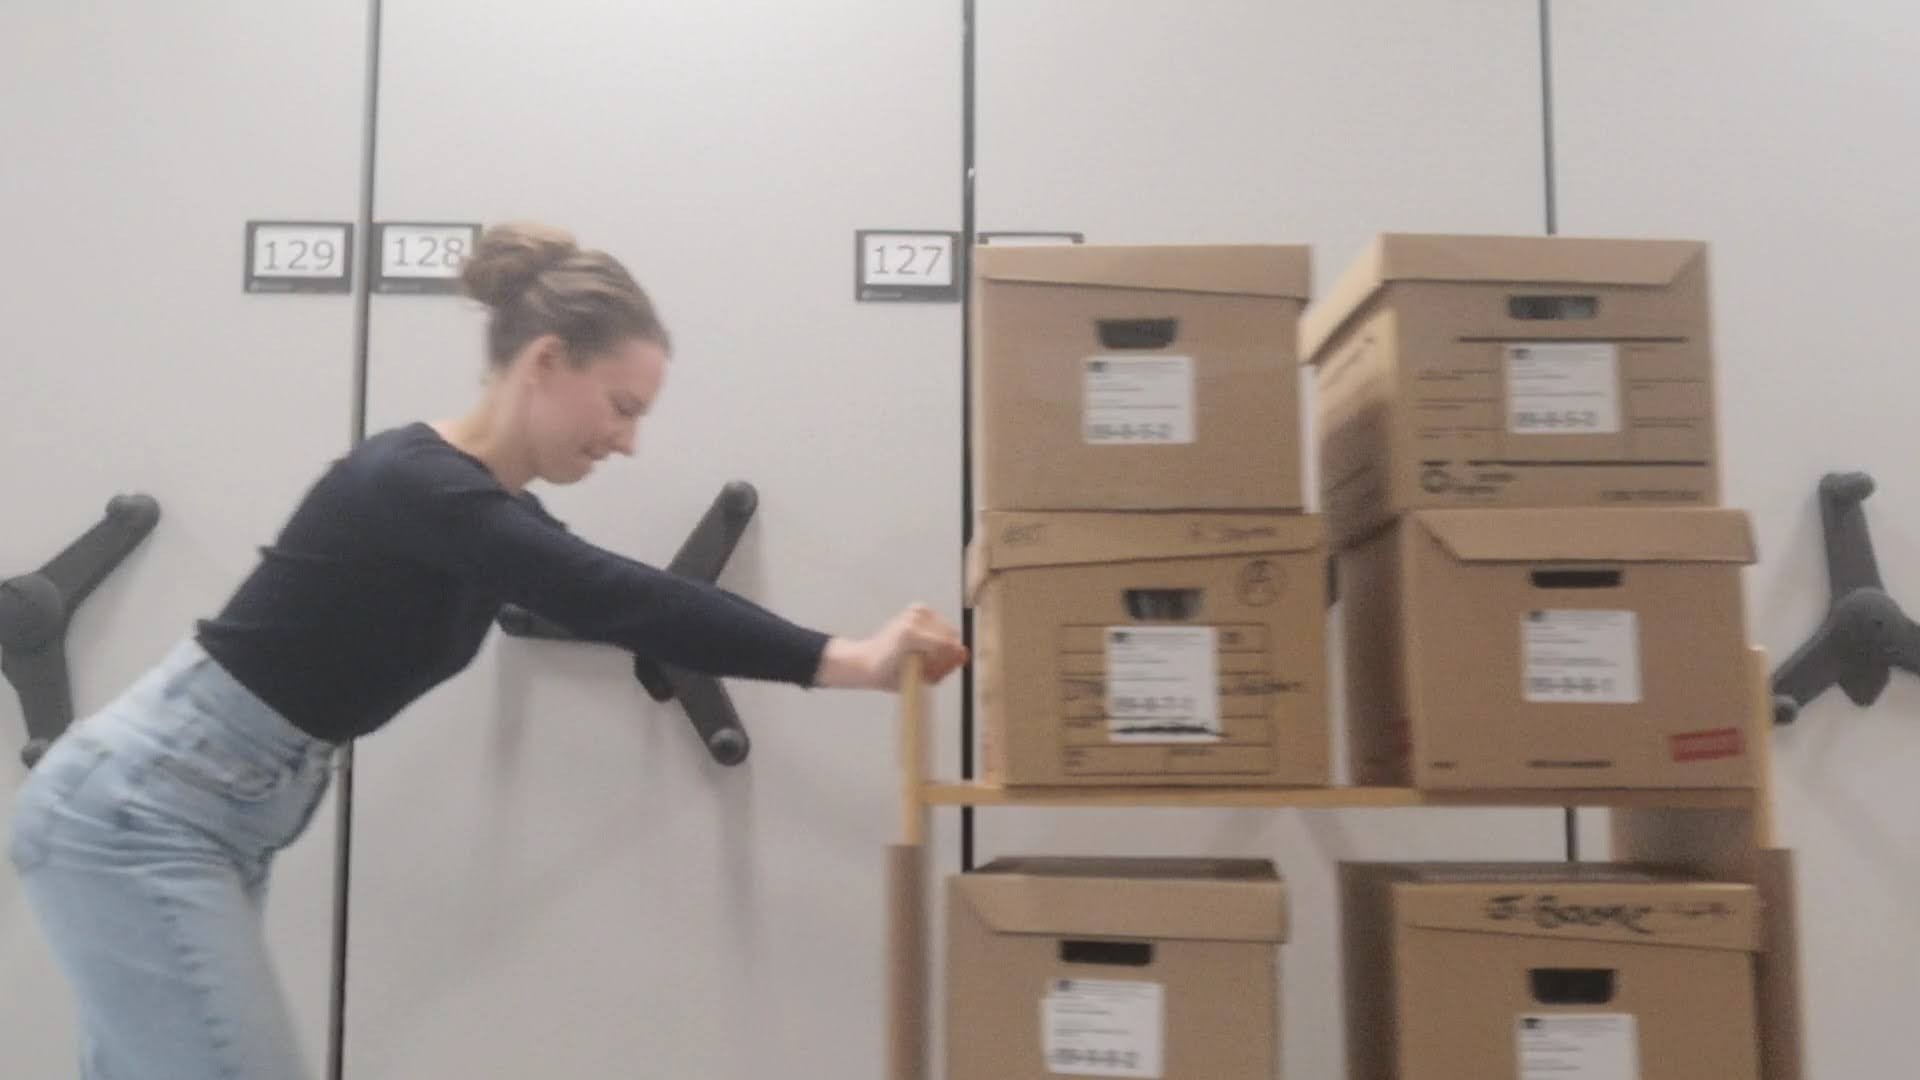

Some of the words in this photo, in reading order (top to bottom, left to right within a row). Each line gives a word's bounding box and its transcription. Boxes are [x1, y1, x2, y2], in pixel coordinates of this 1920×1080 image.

[263, 239, 336, 271] 129
[392, 236, 465, 267] 128
[873, 244, 944, 276] 127
